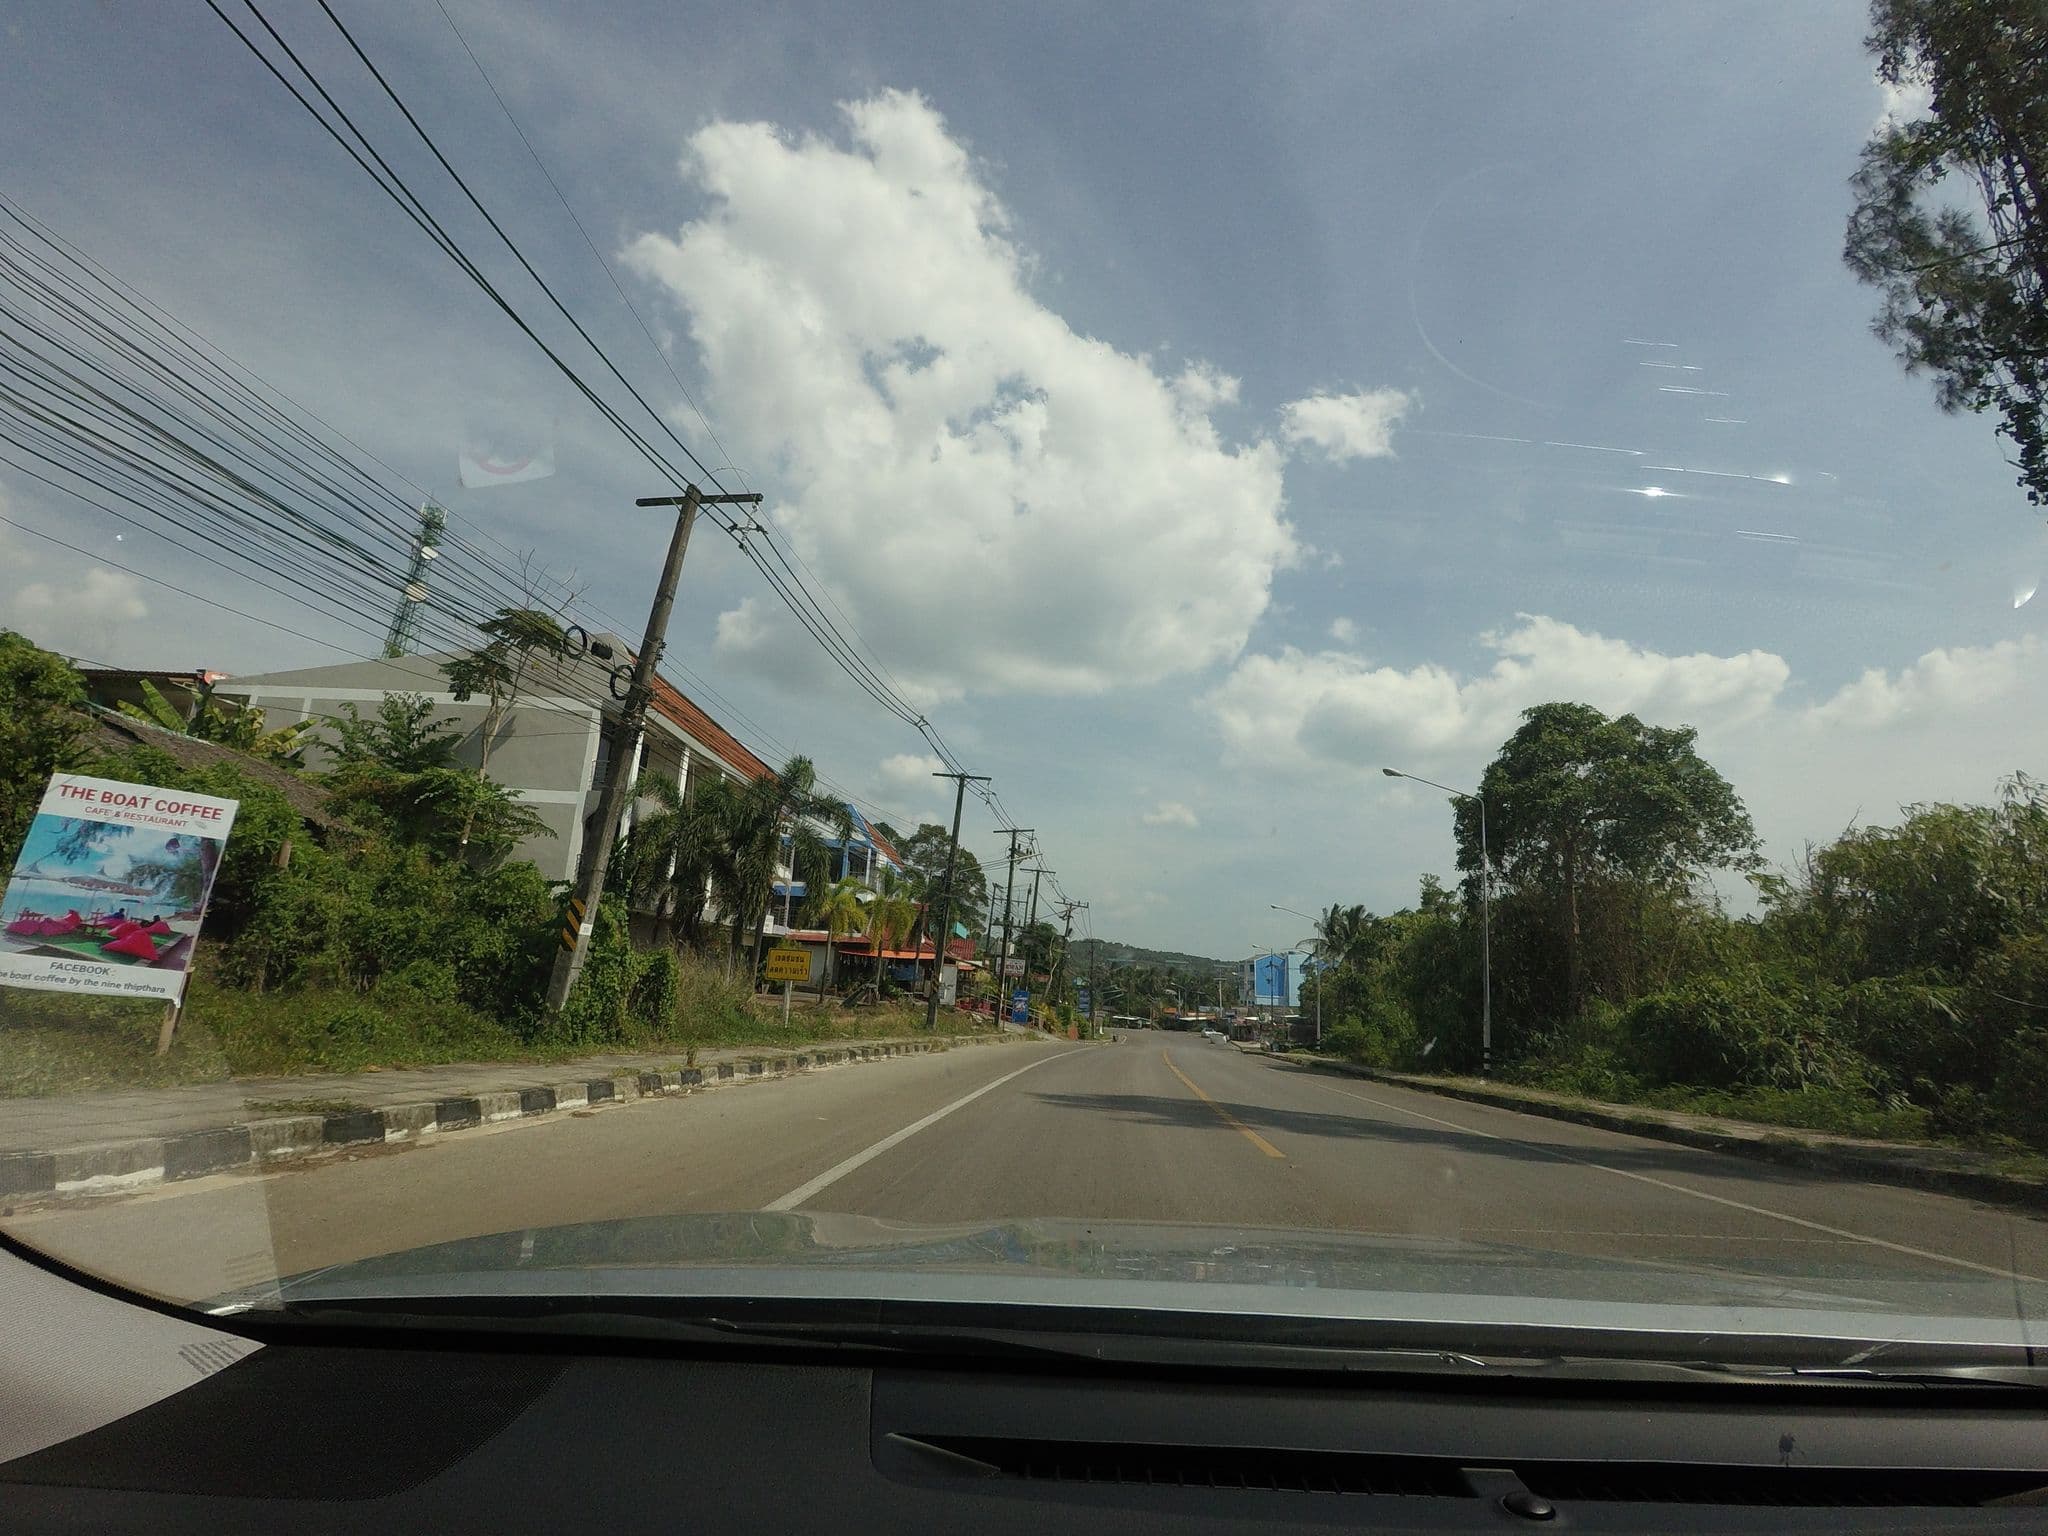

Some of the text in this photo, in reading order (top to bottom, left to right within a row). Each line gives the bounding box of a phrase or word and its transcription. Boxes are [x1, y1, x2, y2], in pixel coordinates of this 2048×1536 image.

[60, 784, 224, 820] THE BOAT COFFEE
[123, 812, 189, 828] RESTAURANT
[9, 971, 32, 981] boat
[34, 974, 67, 985] coffee
[69, 977, 81, 987] by
[84, 978, 99, 987] the
[101, 981, 122, 990] nine
[124, 983, 166, 995] thipthara
